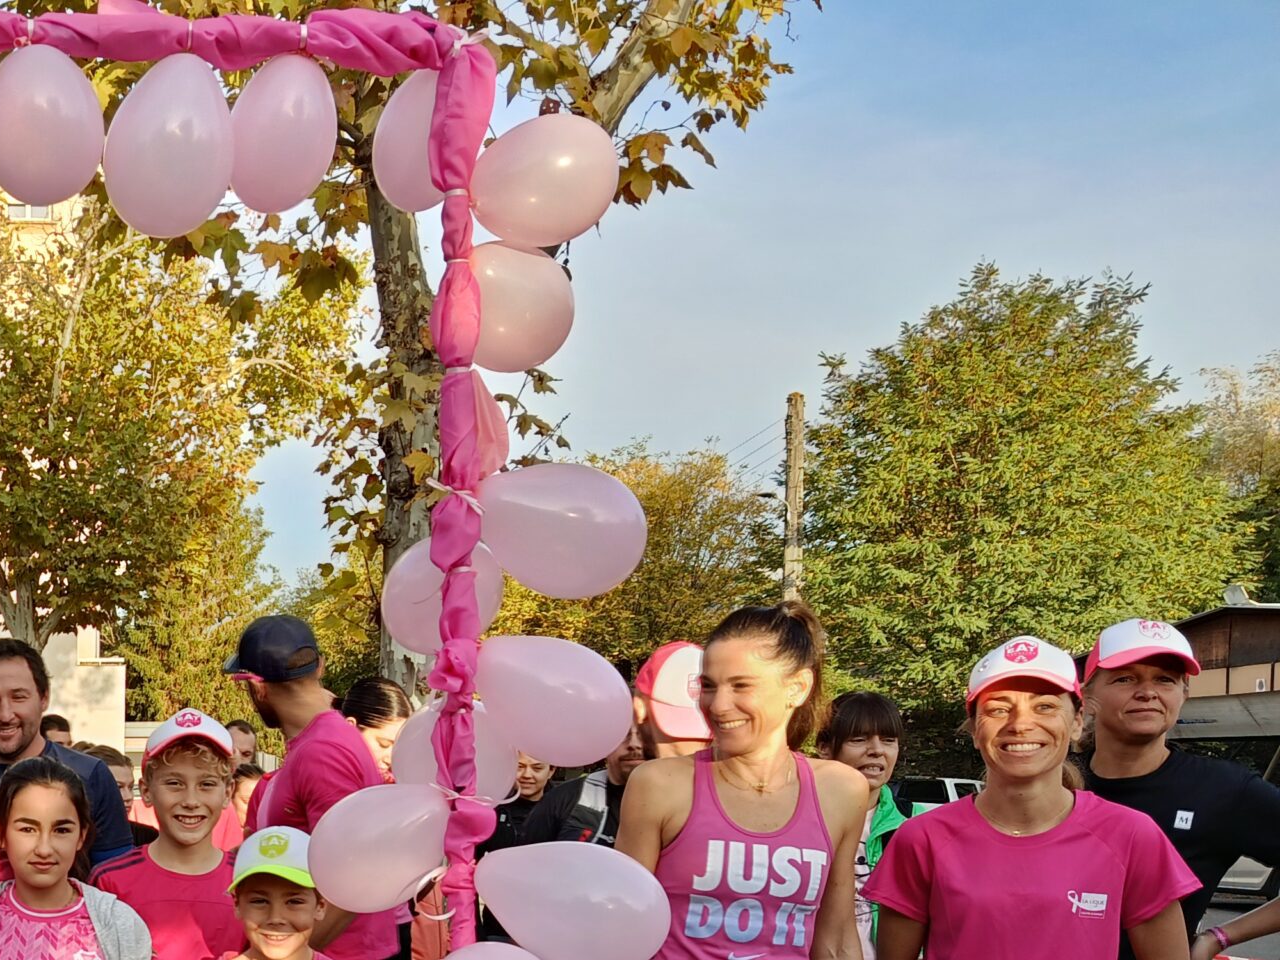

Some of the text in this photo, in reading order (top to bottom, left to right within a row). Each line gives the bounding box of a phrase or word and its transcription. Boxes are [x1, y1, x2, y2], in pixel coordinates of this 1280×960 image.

[1006, 643, 1036, 654] EAT
[177, 713, 200, 721] EAT
[692, 839, 827, 901] JUST
[684, 893, 764, 943] DO
[772, 902, 816, 947] IT
